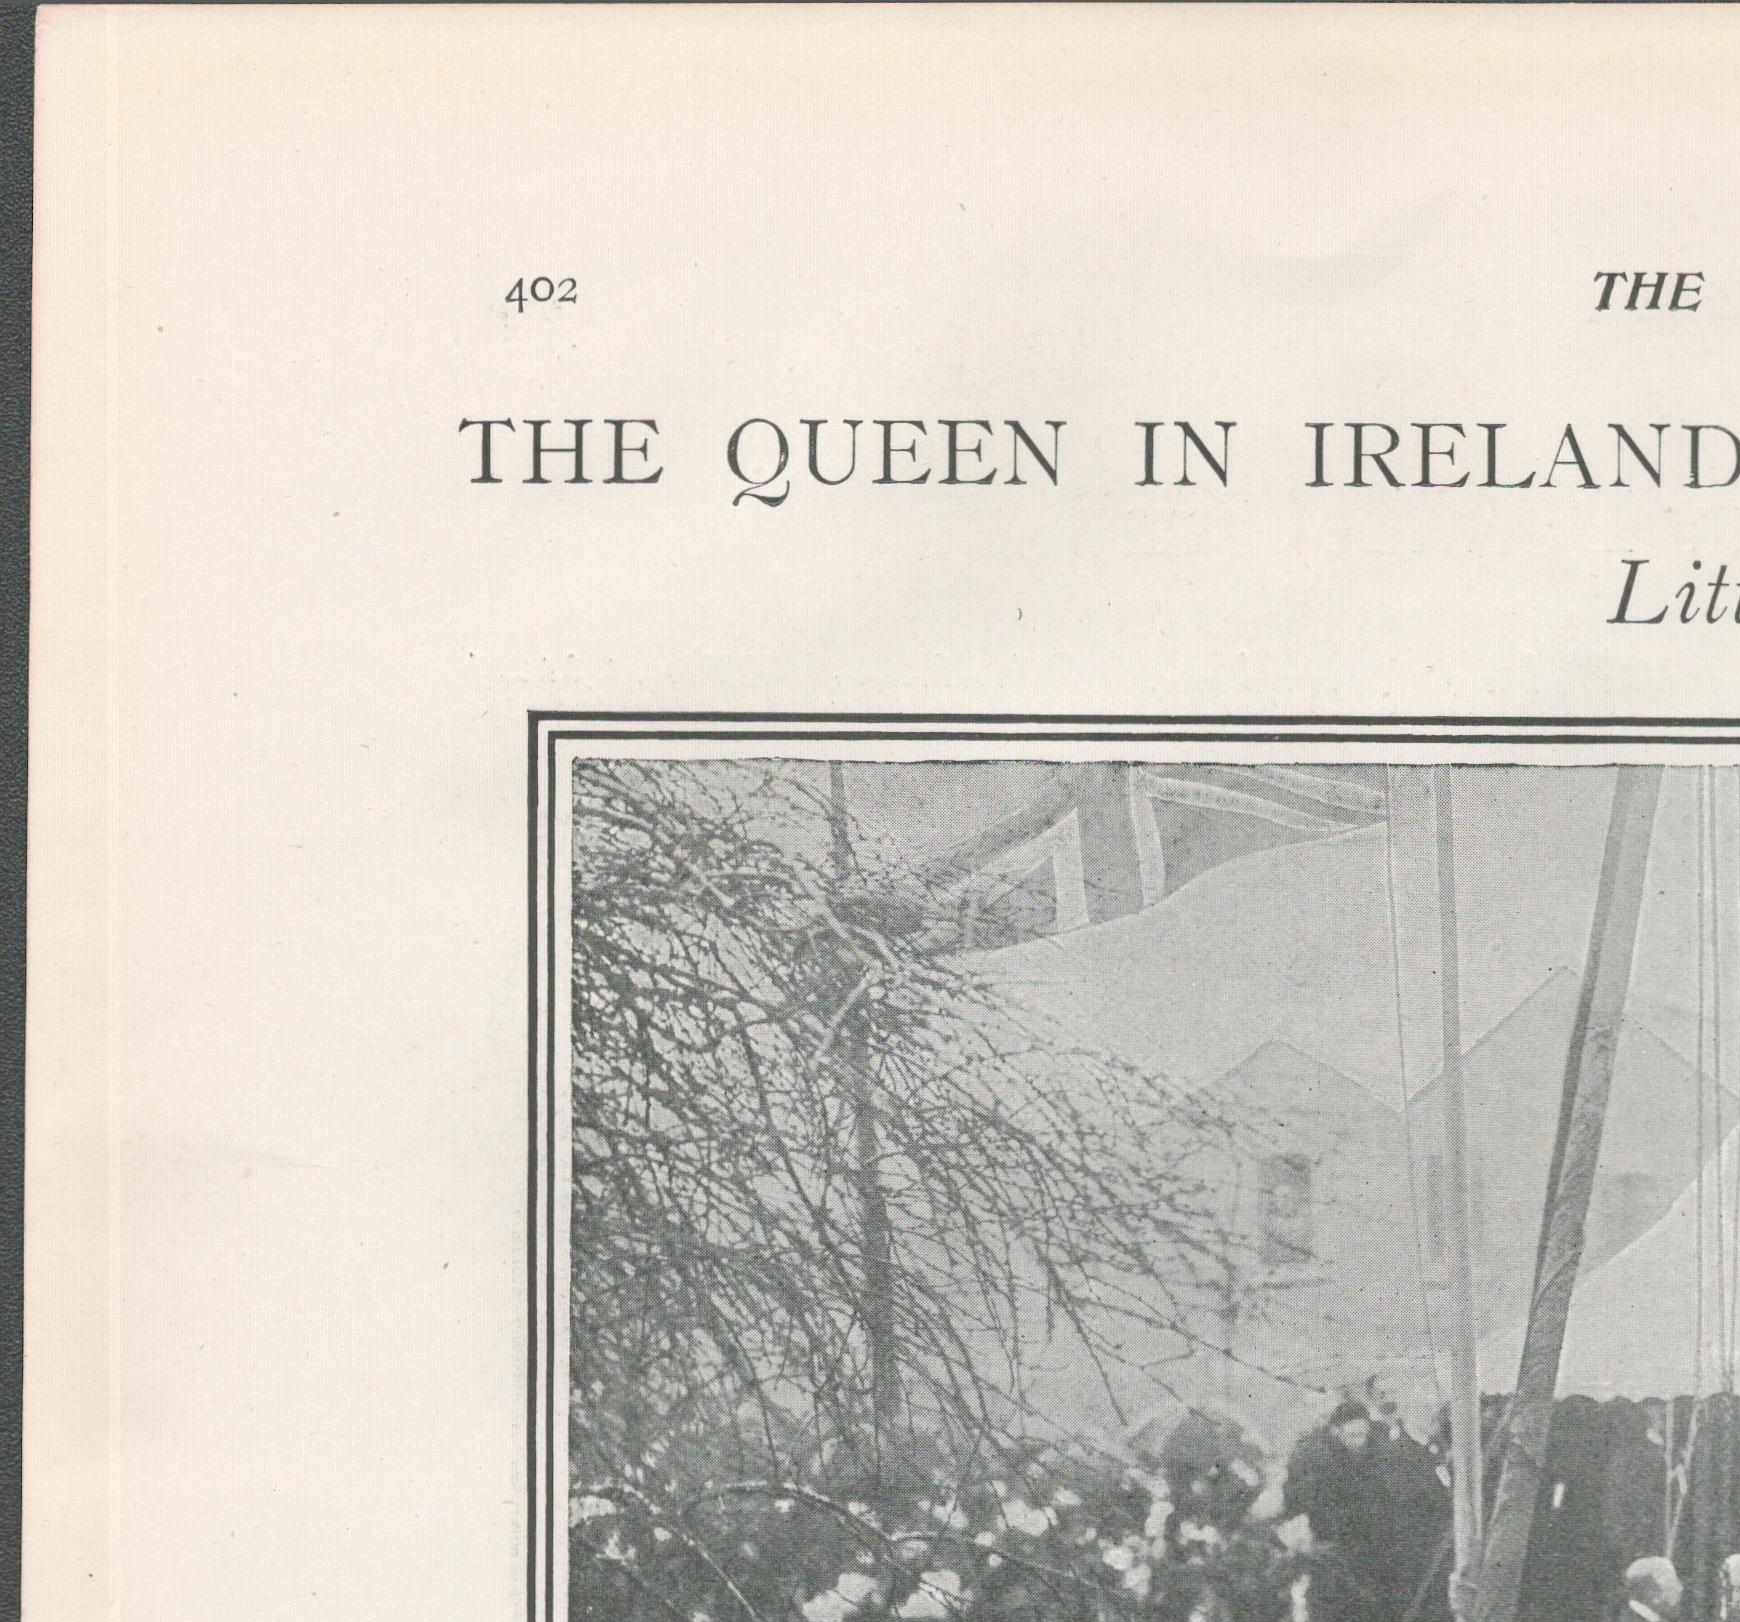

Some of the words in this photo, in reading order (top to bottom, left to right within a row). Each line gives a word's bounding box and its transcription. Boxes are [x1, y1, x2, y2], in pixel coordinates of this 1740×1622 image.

[505, 276, 577, 313] 402
[1593, 271, 1705, 312] THE
[458, 417, 664, 484] THE
[727, 418, 1067, 508] QUEEN
[1135, 420, 1237, 488] IN
